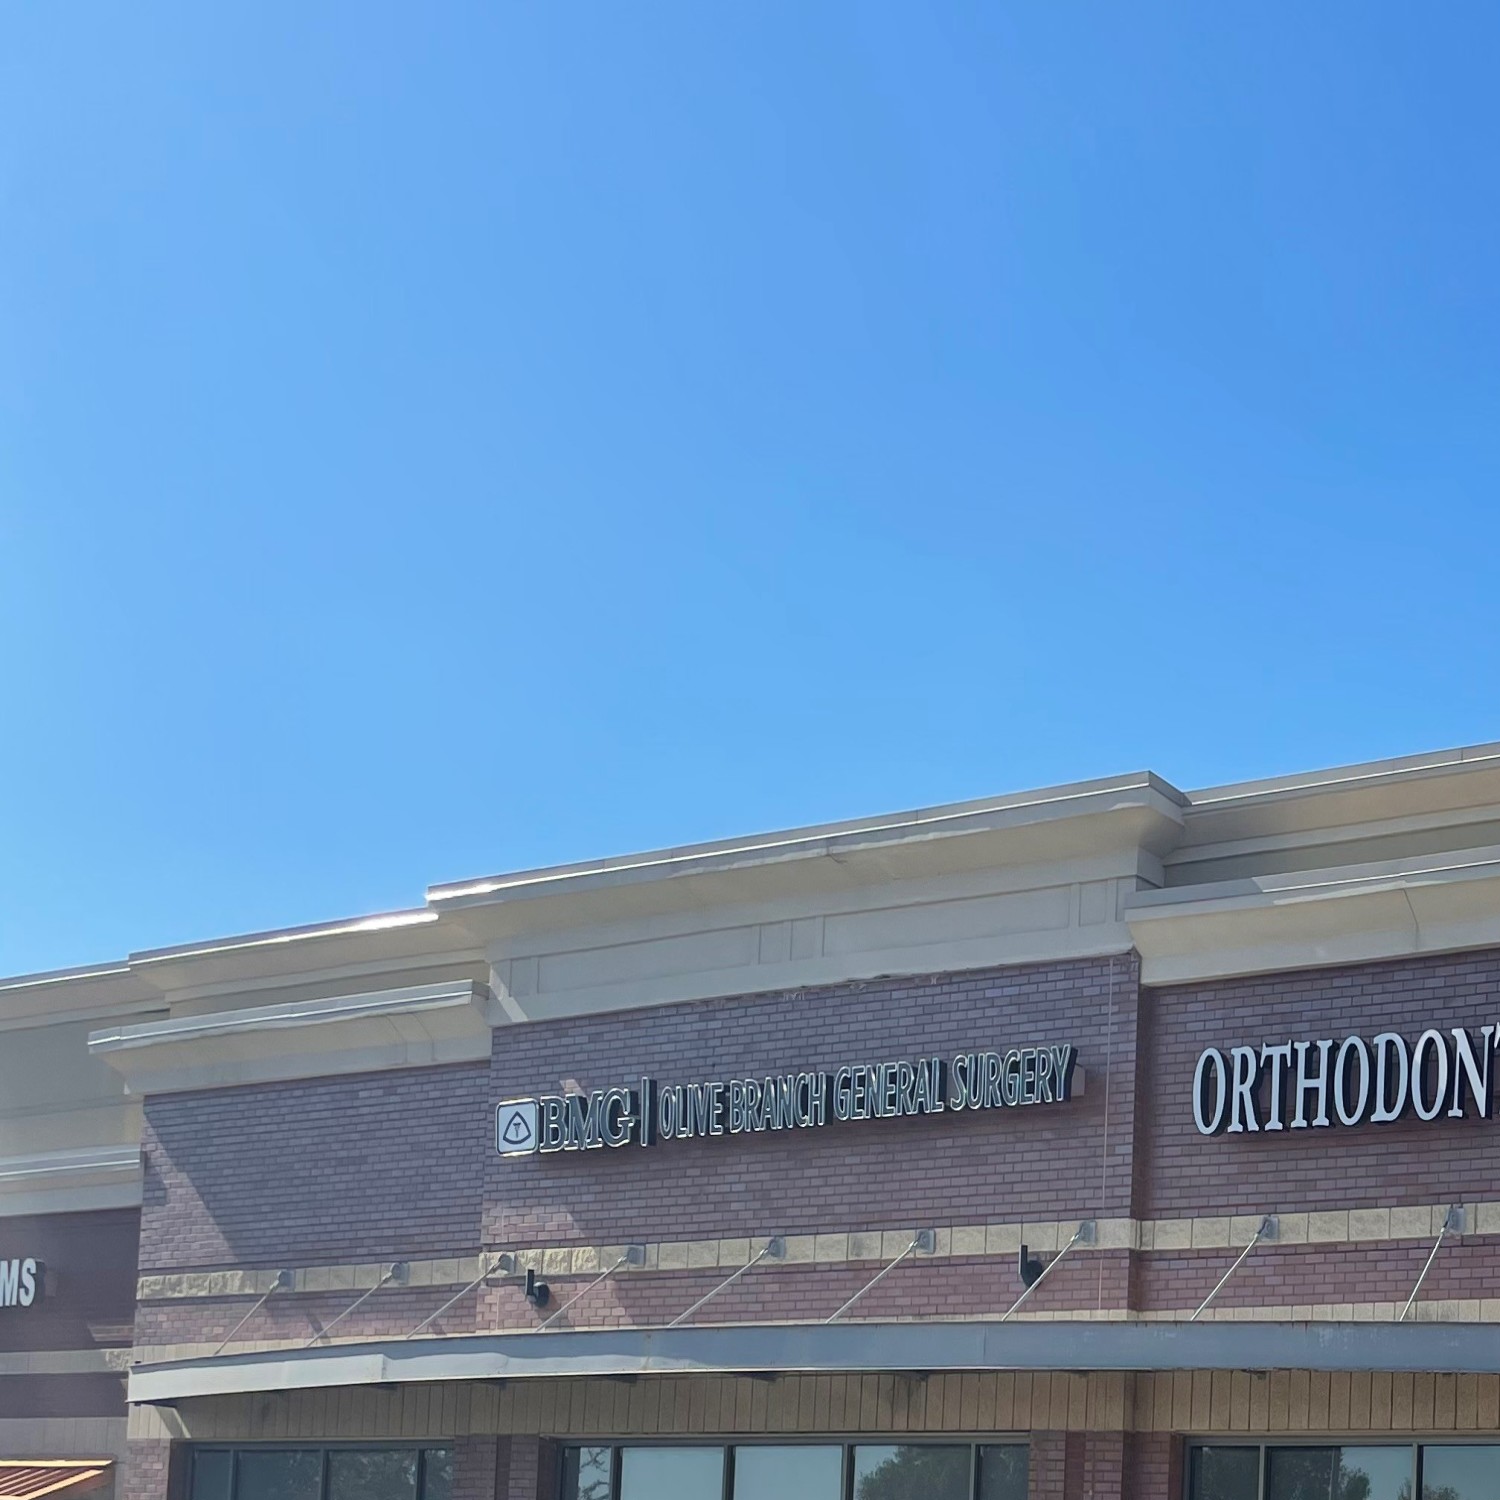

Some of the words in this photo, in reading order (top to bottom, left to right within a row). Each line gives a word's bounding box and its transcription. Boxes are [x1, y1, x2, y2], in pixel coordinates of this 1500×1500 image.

[540, 1087, 635, 1153] BMG
[658, 1082, 724, 1140] OLIVE
[729, 1071, 828, 1135] BRANCH
[833, 1057, 945, 1122] GENERAL
[950, 1043, 1072, 1112] SURGERY
